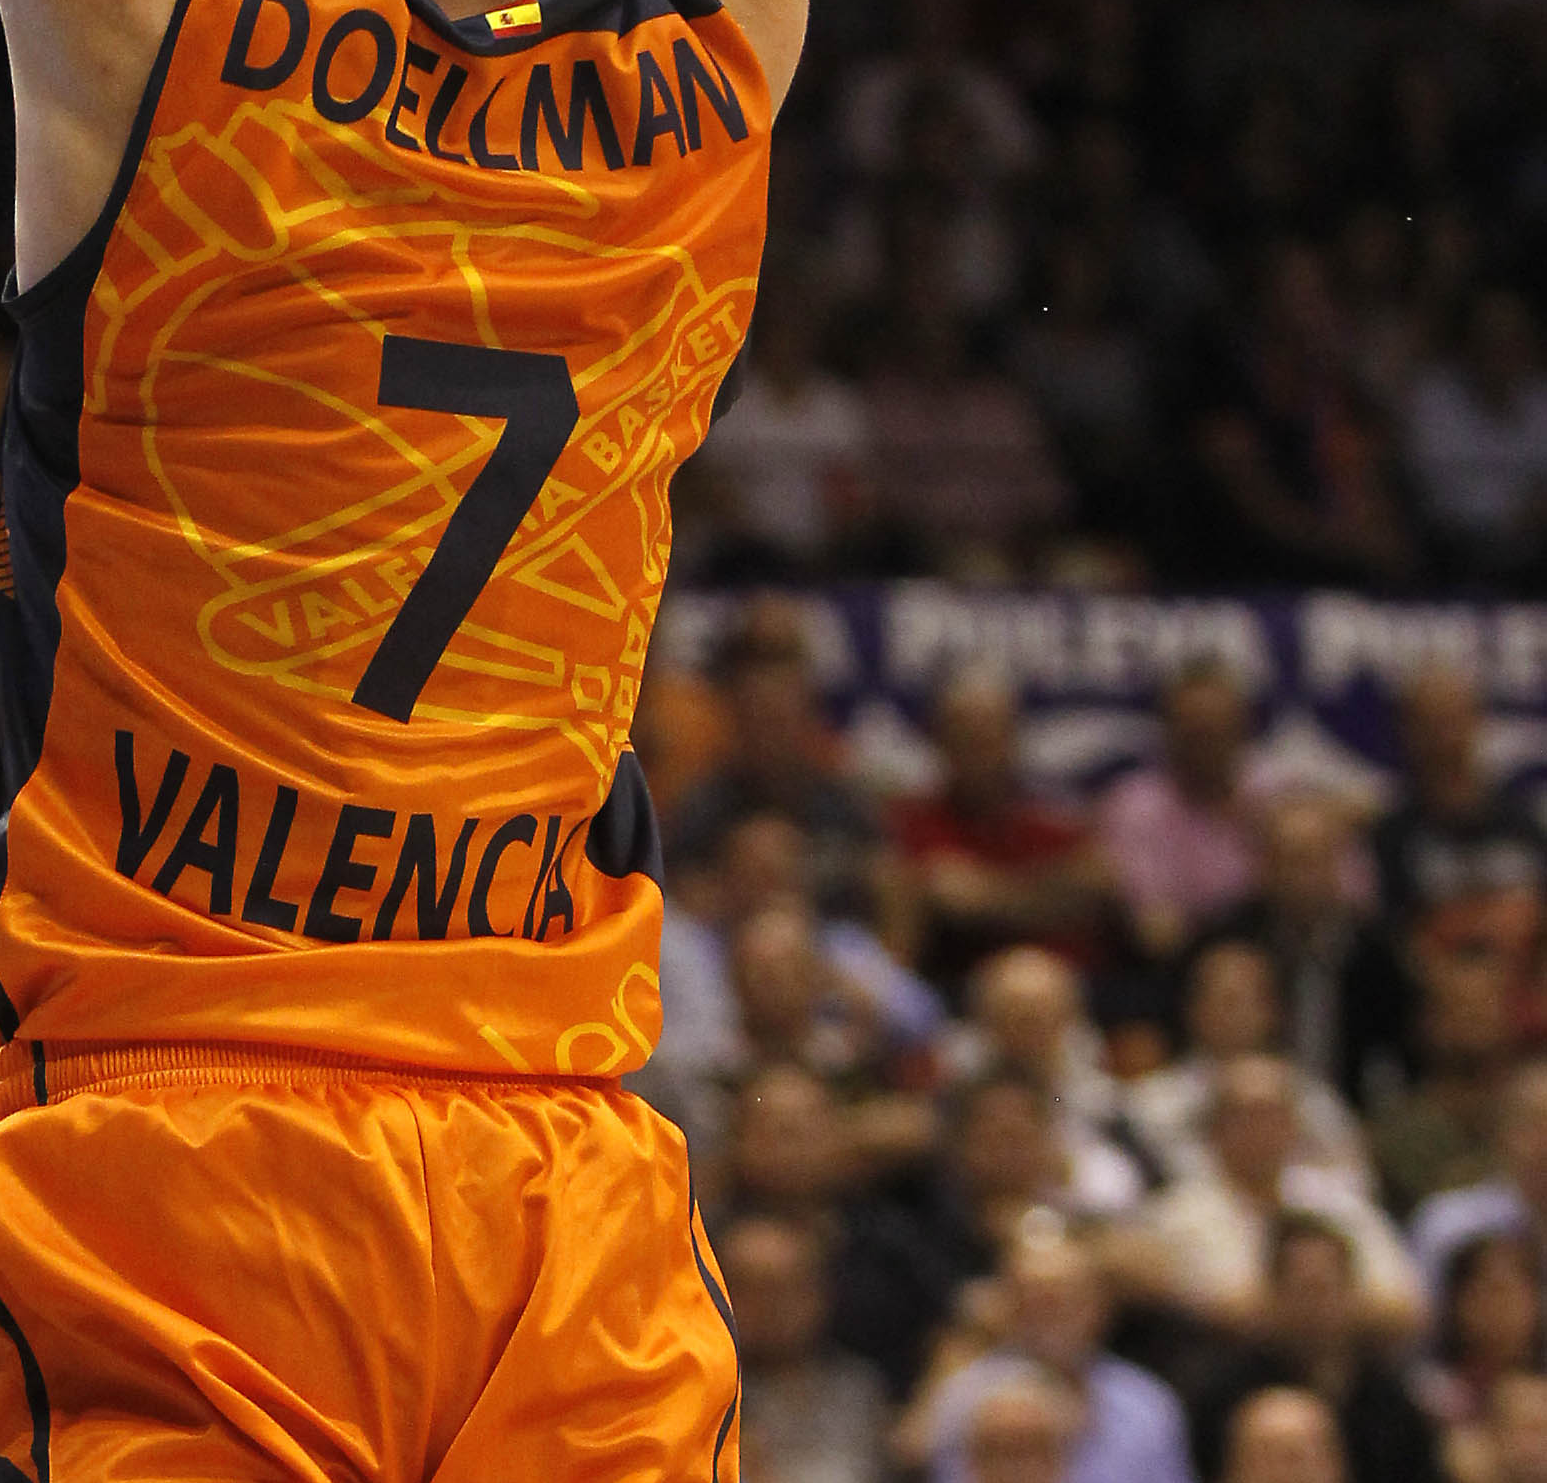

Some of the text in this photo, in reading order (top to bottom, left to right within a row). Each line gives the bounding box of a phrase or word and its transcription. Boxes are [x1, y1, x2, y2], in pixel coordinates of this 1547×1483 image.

[581, 300, 742, 476] BASKET
[351, 334, 582, 724] 7
[114, 729, 586, 944] VALENCIA
